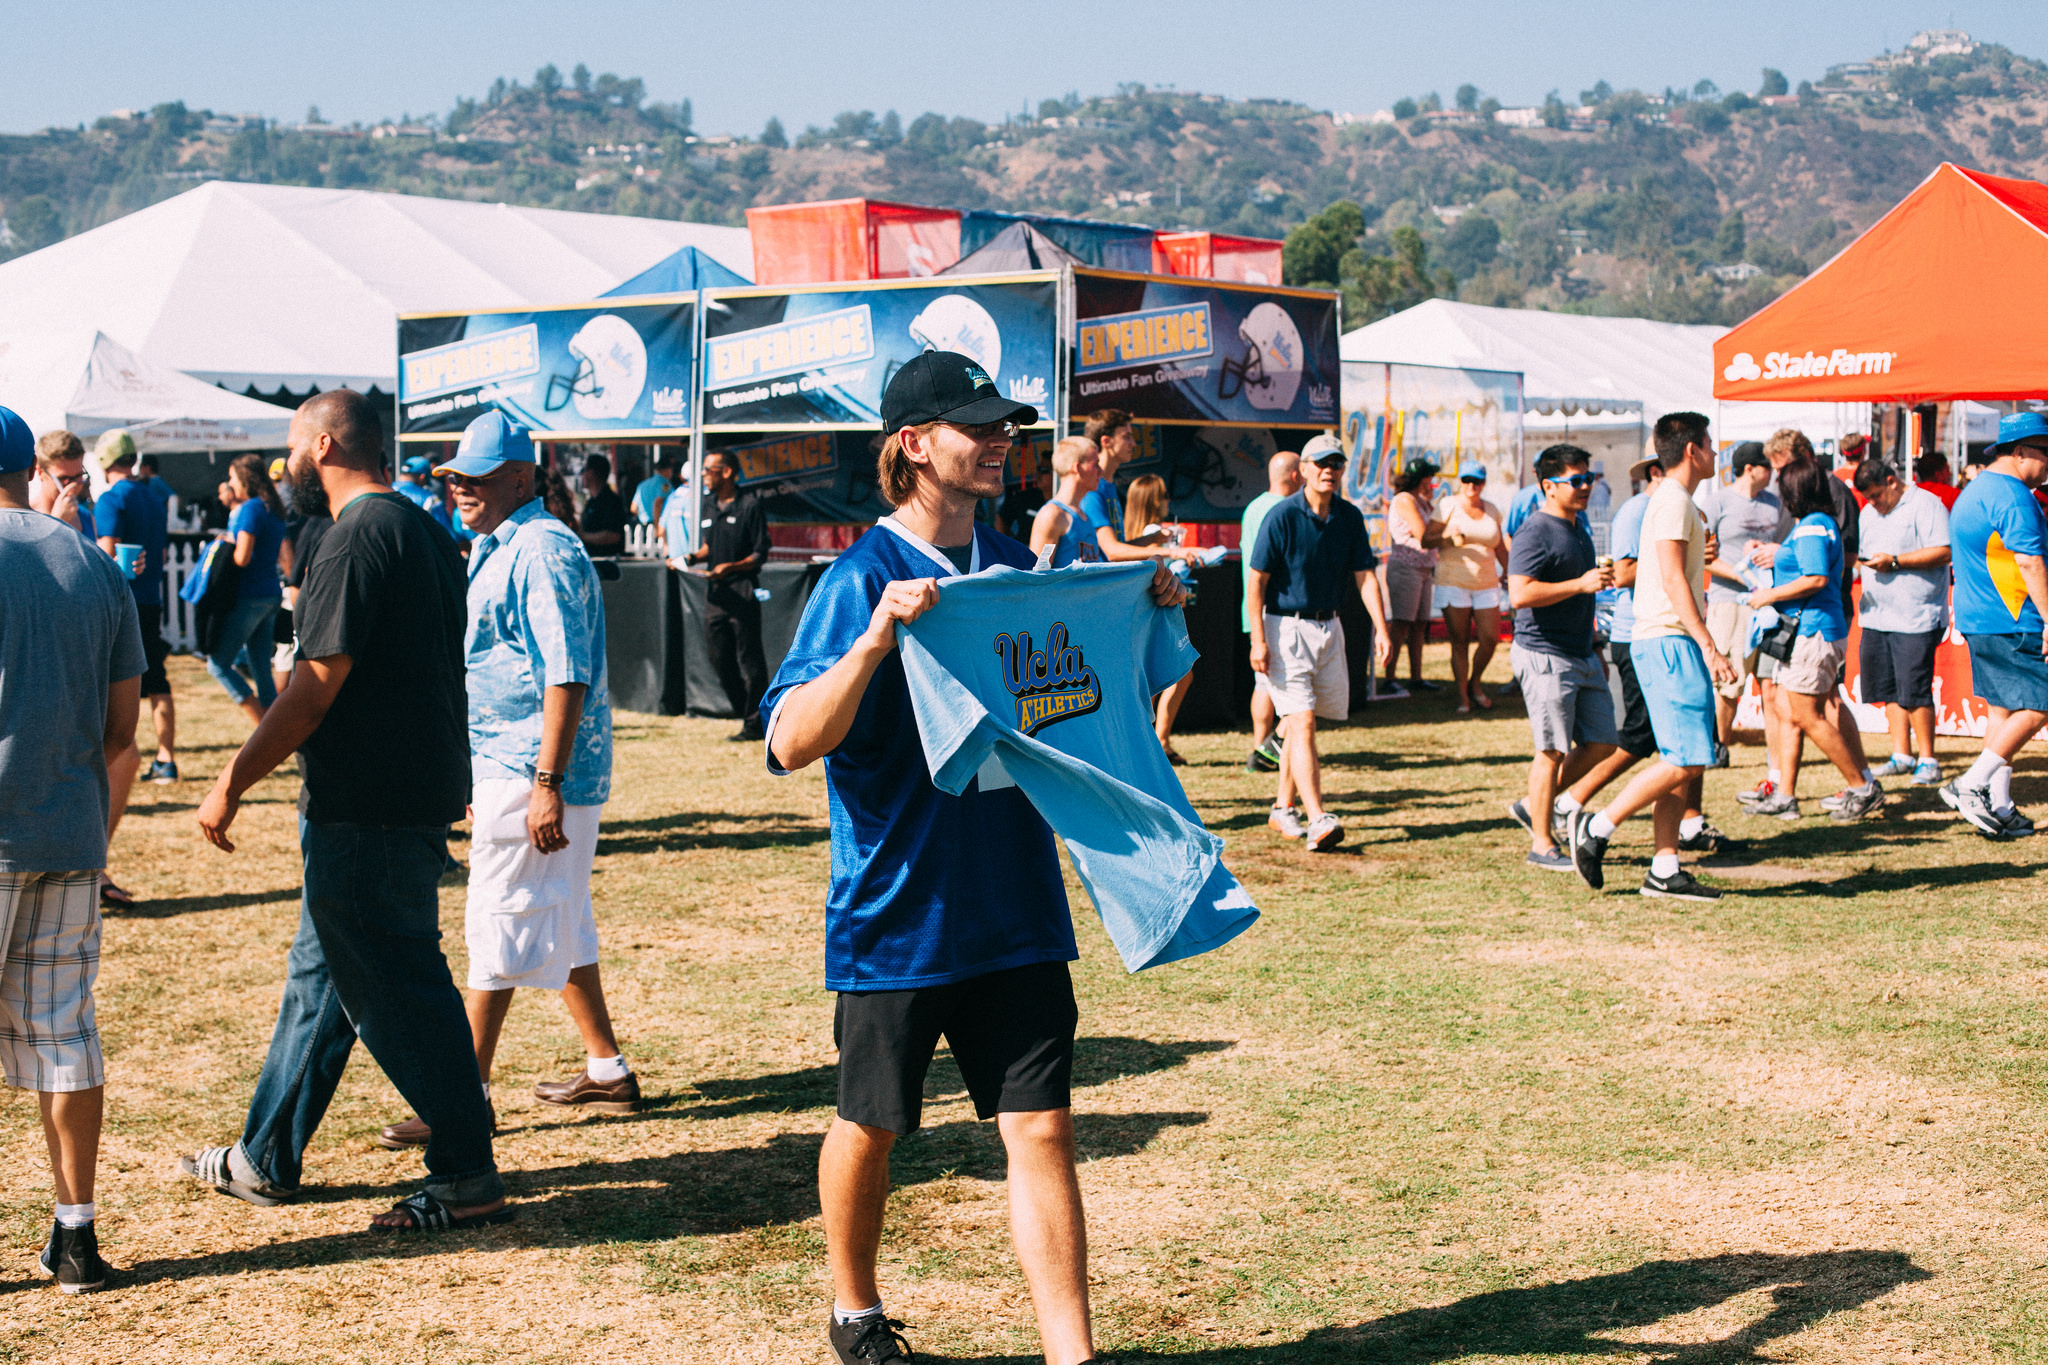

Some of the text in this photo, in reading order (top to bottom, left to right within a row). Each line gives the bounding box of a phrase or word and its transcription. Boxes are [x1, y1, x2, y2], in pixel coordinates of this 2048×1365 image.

[713, 313, 867, 382] EXPERIENCE
[1080, 309, 1209, 367] EXPERIENCE
[407, 331, 535, 395] EXPERIENCE
[1080, 376, 1129, 397] Ultimate
[1131, 373, 1153, 388] Fan
[712, 386, 770, 409] Ultimate
[771, 381, 798, 398] Fan
[738, 433, 833, 480] ERIENCE
[1020, 689, 1096, 732] ATHLETICS
